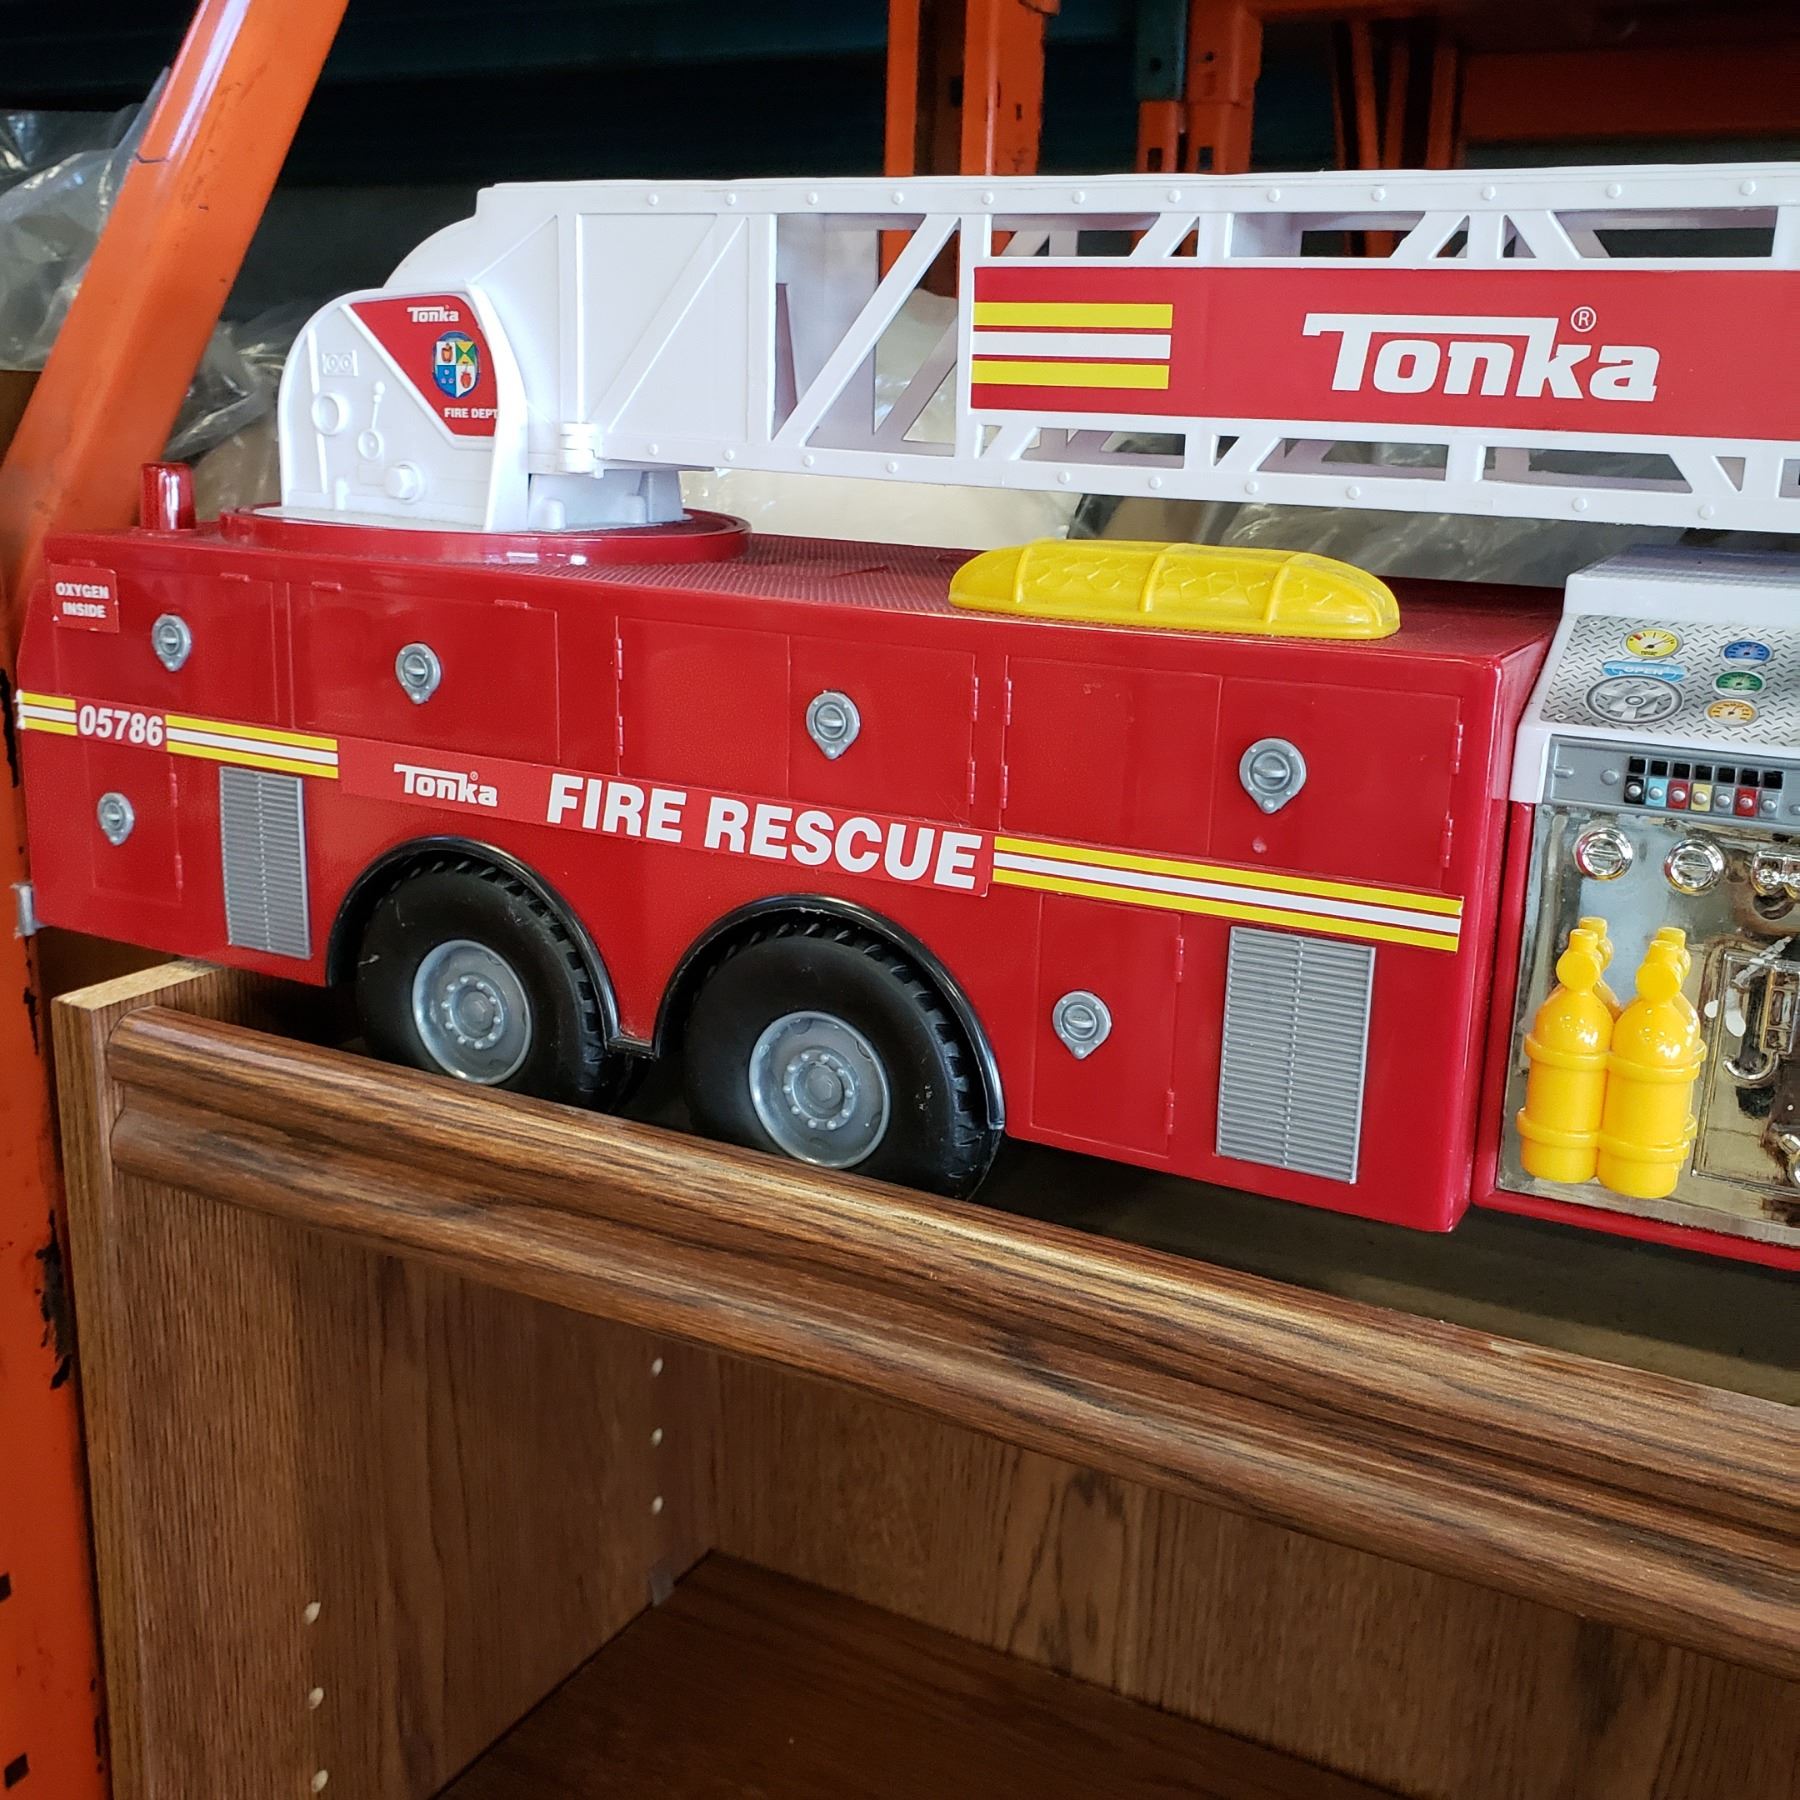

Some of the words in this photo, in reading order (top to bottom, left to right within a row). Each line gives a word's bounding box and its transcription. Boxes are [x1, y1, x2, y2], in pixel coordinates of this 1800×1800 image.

[407, 306, 459, 323] Tonka
[1302, 312, 1661, 402] Tonka
[444, 408, 469, 419] FIRE
[55, 582, 110, 600] OXYGEN
[62, 602, 107, 619] INSIDE
[79, 705, 163, 747] 05786
[393, 763, 498, 807] Tonka
[546, 773, 688, 844] FIRE
[703, 796, 983, 890] RESCUE
